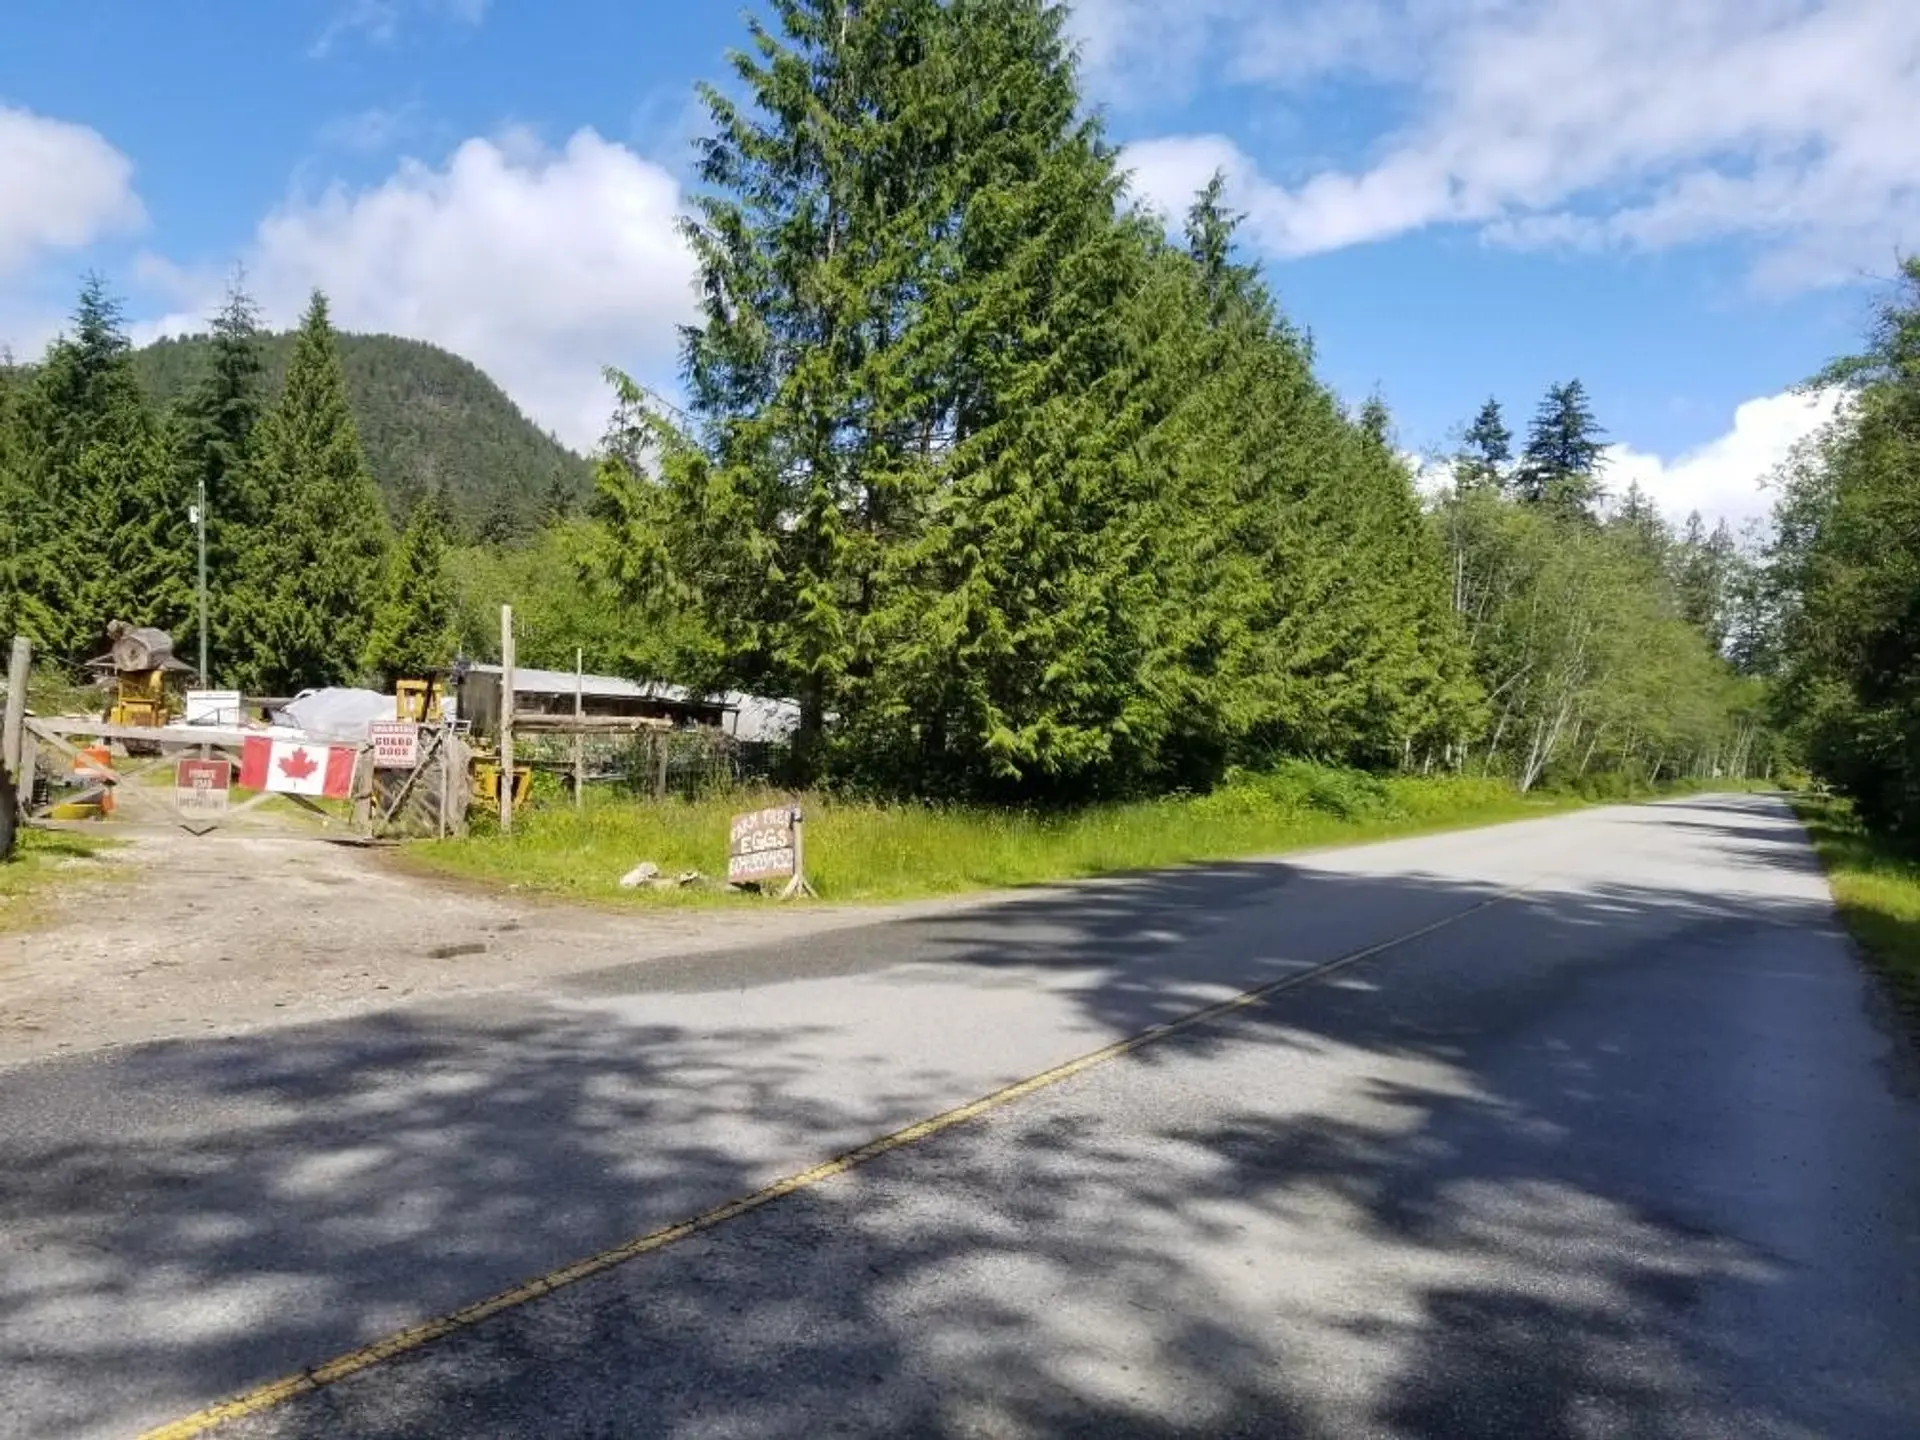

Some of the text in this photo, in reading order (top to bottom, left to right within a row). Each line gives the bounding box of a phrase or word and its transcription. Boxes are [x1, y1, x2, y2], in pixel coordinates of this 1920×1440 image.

[375, 737, 412, 746] GUARD
[379, 747, 408, 756] DOGS
[740, 828, 788, 854] EGGS
